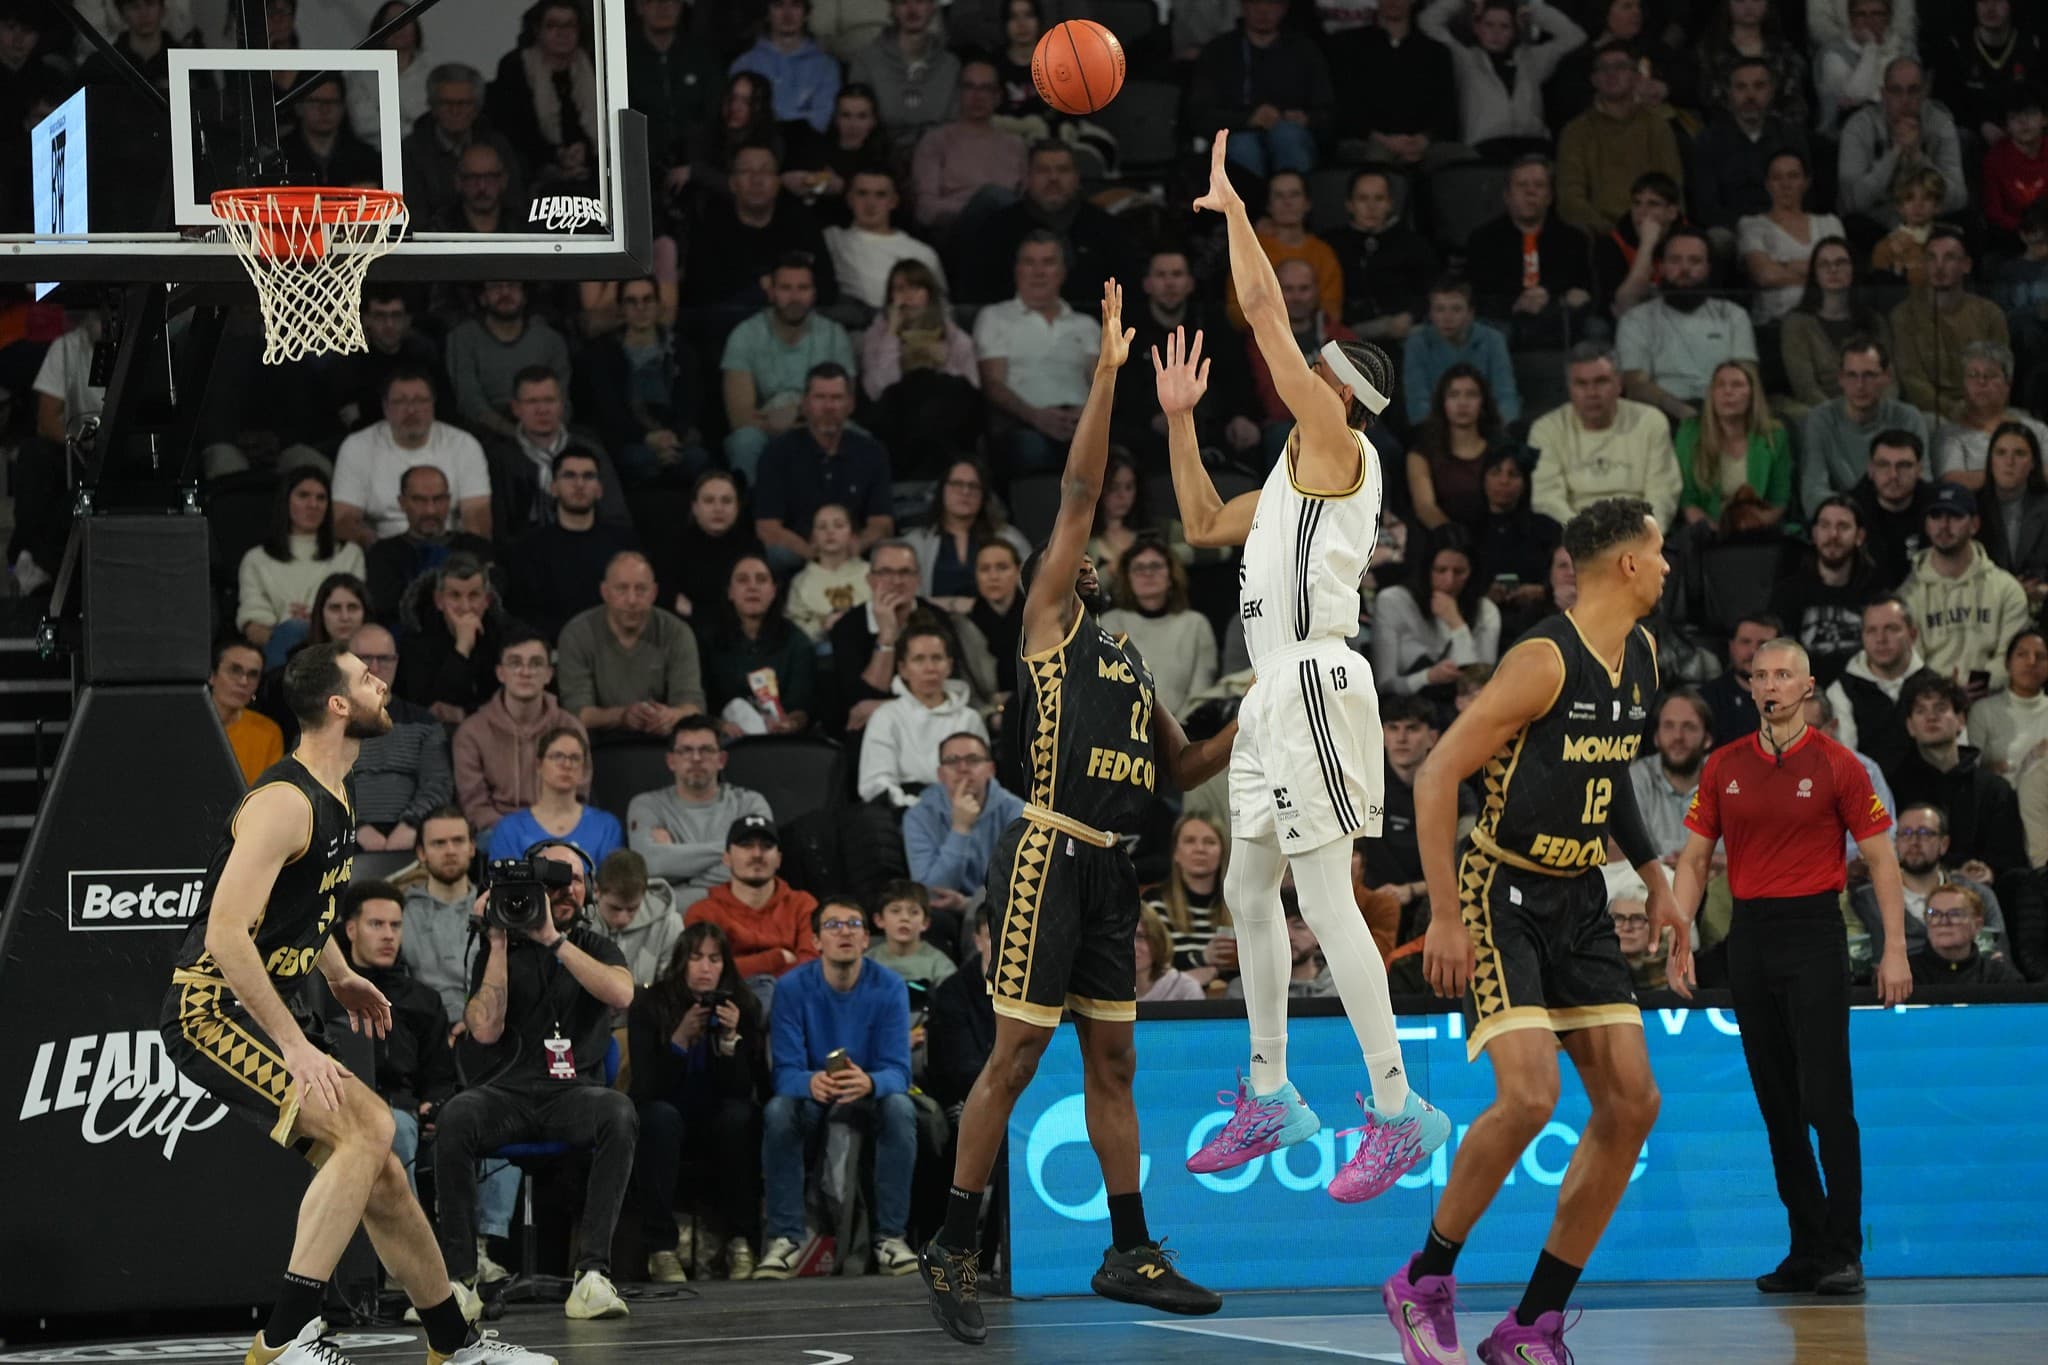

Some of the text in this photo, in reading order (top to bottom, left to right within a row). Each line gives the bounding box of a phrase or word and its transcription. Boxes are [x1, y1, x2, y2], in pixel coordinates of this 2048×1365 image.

[528, 195, 607, 227] LEADERS
[546, 209, 591, 236] Cup
[1329, 666, 1349, 692] 13
[1562, 733, 1642, 763] MONACO
[1087, 747, 1156, 796] FEDCO
[1581, 778, 1613, 825] 12
[1529, 833, 1608, 868] FEDCO
[82, 880, 204, 920] Betcli
[19, 1030, 212, 1121] LEAD
[81, 1069, 230, 1161] Cup
